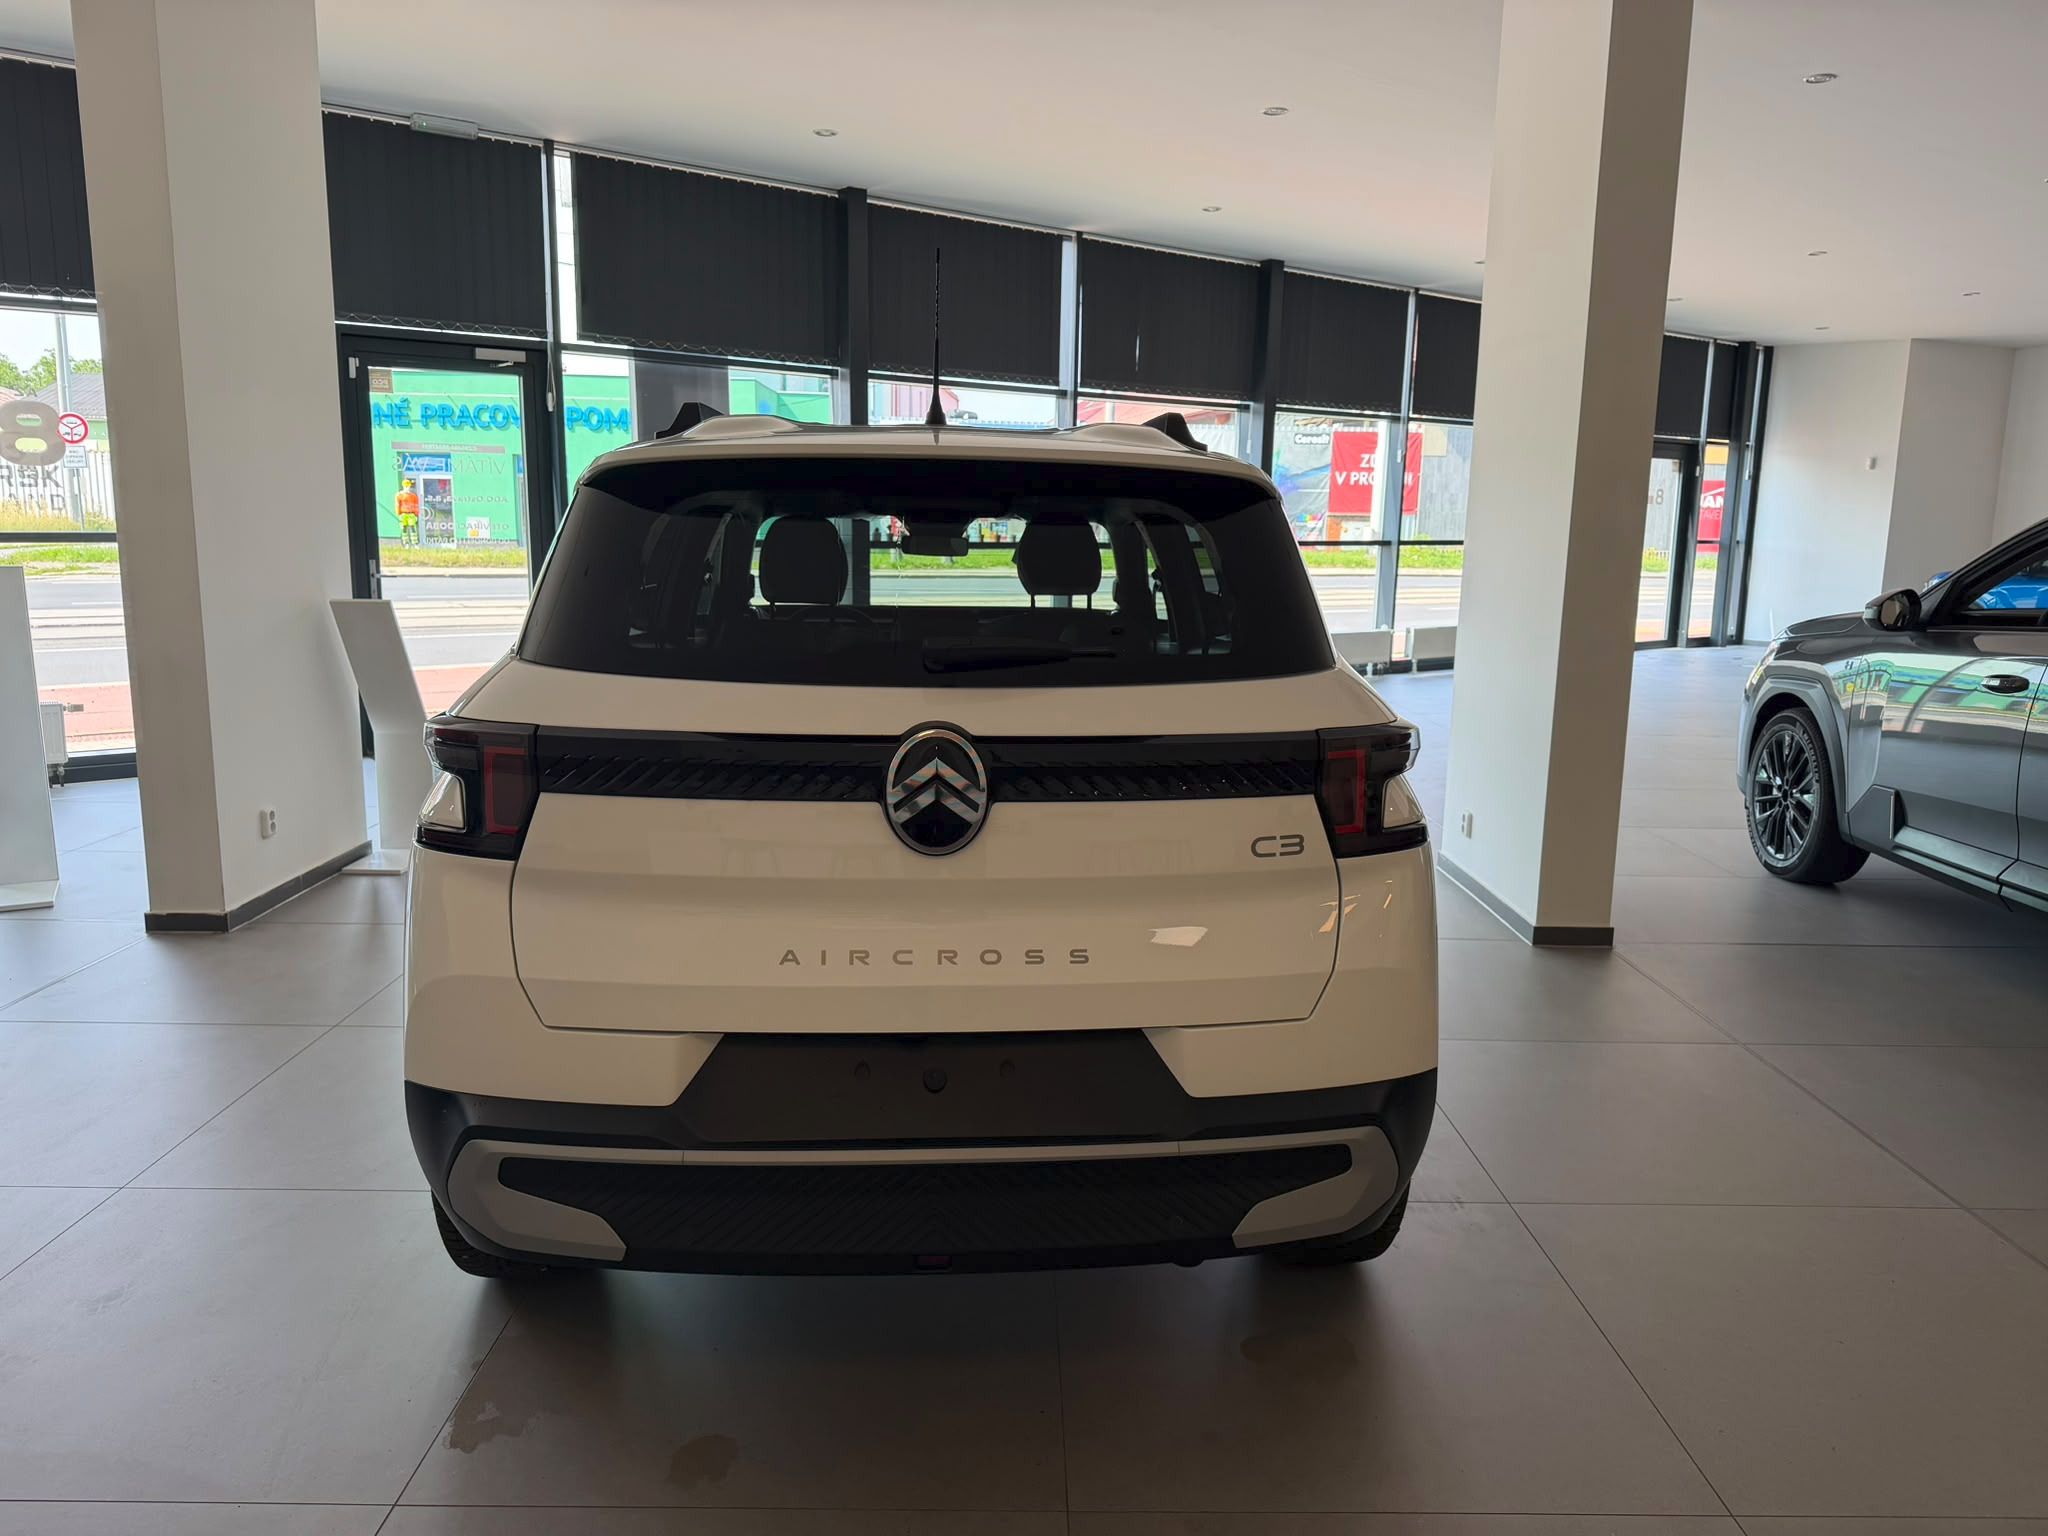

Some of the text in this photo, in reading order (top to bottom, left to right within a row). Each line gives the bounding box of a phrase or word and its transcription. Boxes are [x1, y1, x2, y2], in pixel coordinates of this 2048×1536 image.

[372, 397, 411, 428] NÉ
[566, 405, 630, 432] POM
[1335, 471, 1347, 486] V
[1251, 834, 1304, 858] C3
[778, 948, 1090, 966] AIRCROSS
